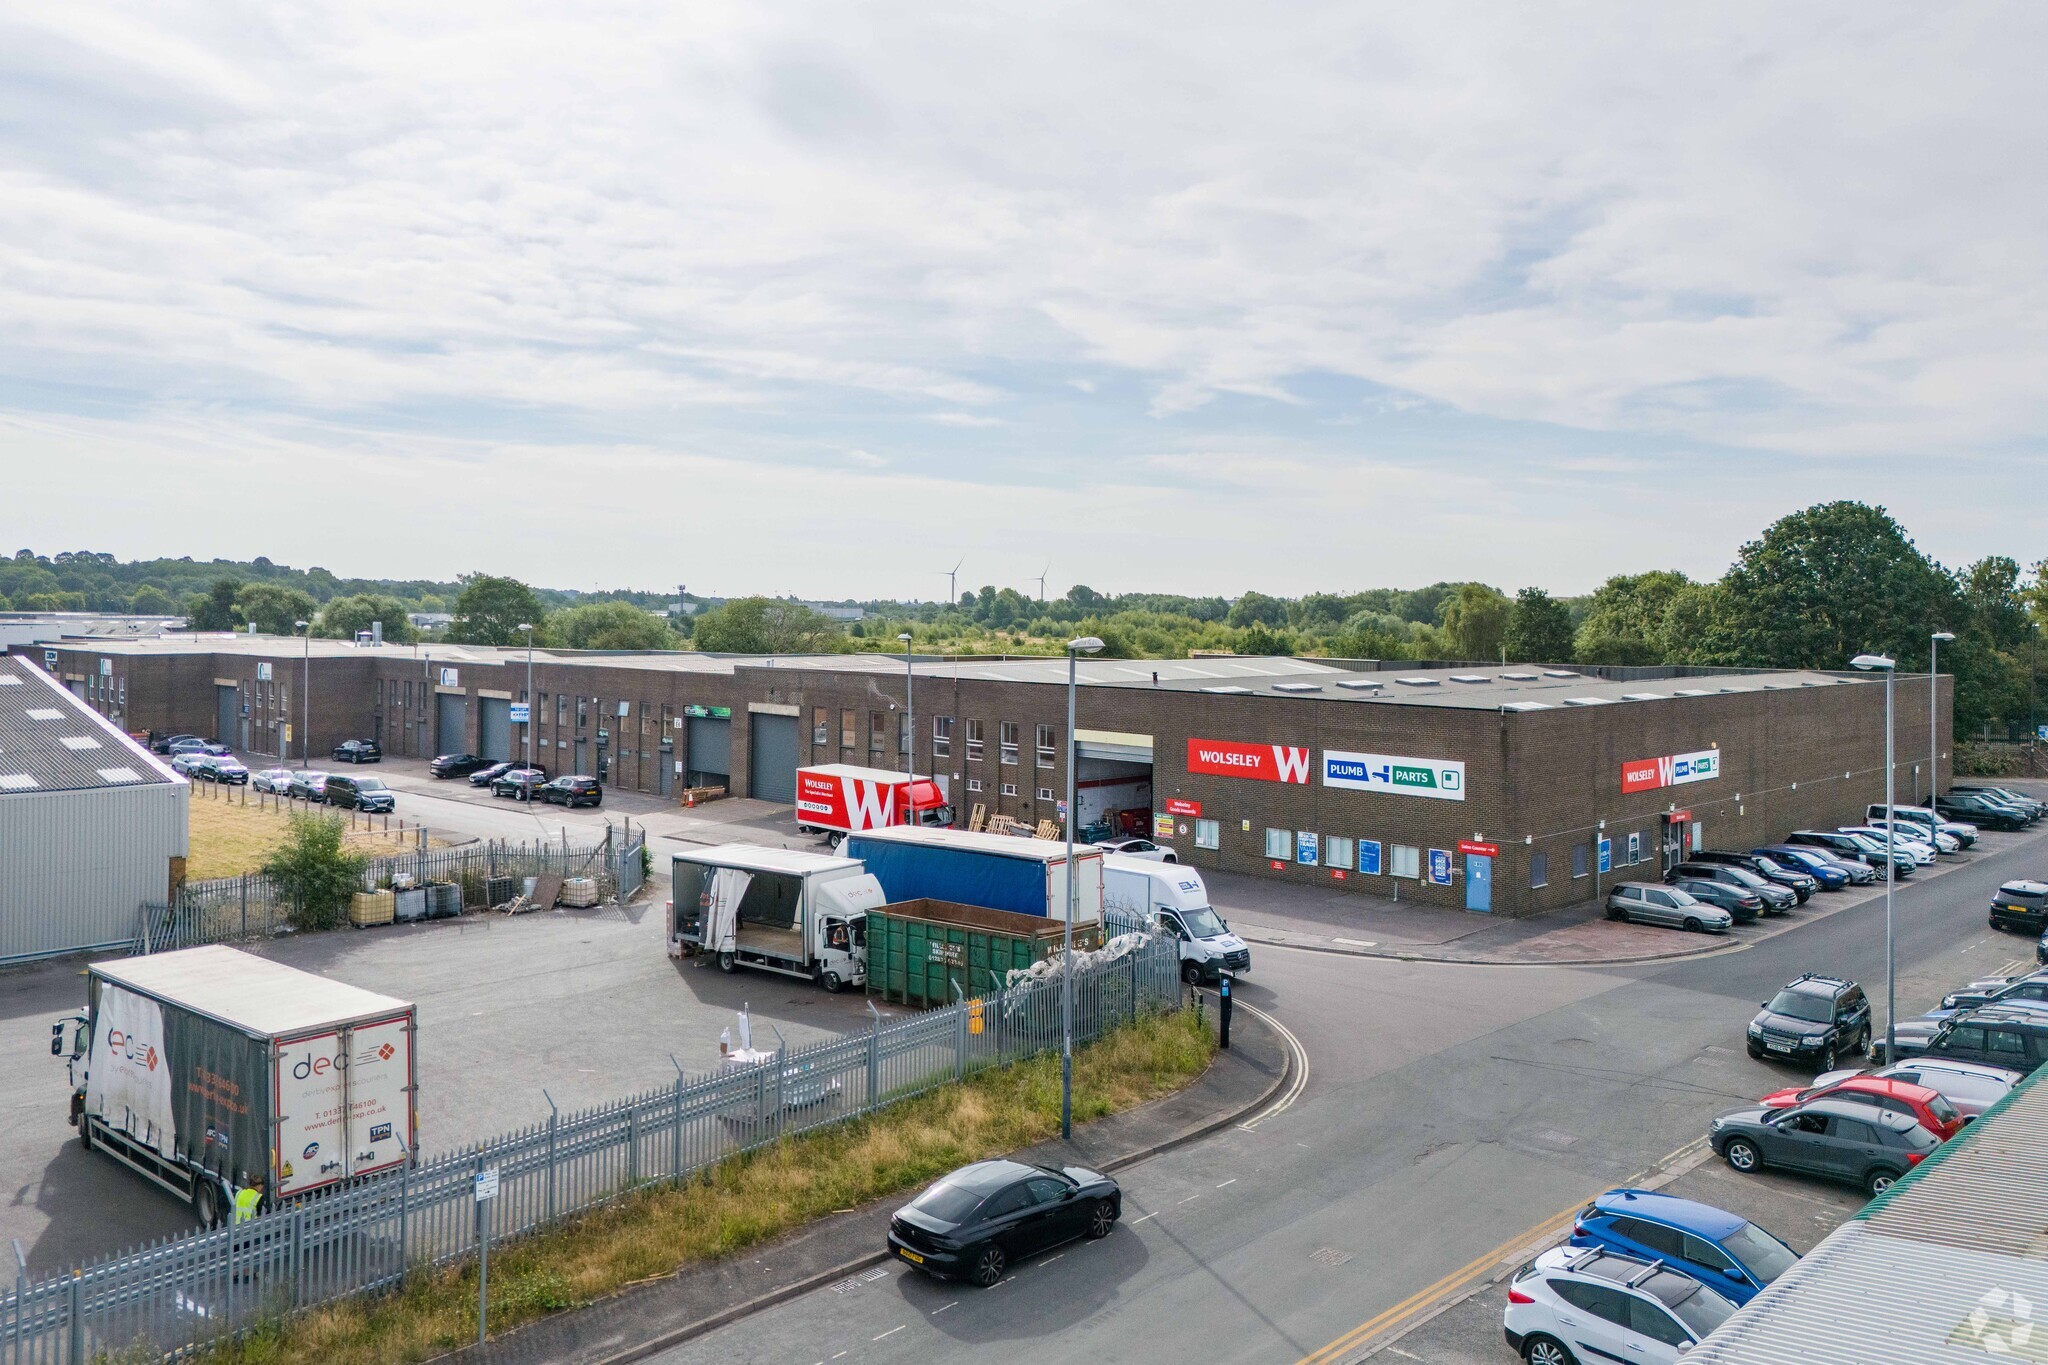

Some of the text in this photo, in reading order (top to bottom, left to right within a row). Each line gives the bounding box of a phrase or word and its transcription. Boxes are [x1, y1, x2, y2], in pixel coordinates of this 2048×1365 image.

[1200, 750, 1261, 768] WOLSELEY
[1272, 745, 1309, 784] W
[1330, 764, 1363, 776] PLUMB
[1396, 770, 1428, 783] PARTS
[1626, 768, 1655, 783] WOLSELEY
[1658, 756, 1673, 787] W
[1675, 764, 1688, 774] PLUMB
[805, 779, 833, 790] WOLSELEY
[841, 777, 894, 830] W
[293, 1053, 349, 1080] dec
[371, 1124, 390, 1135] TPN
